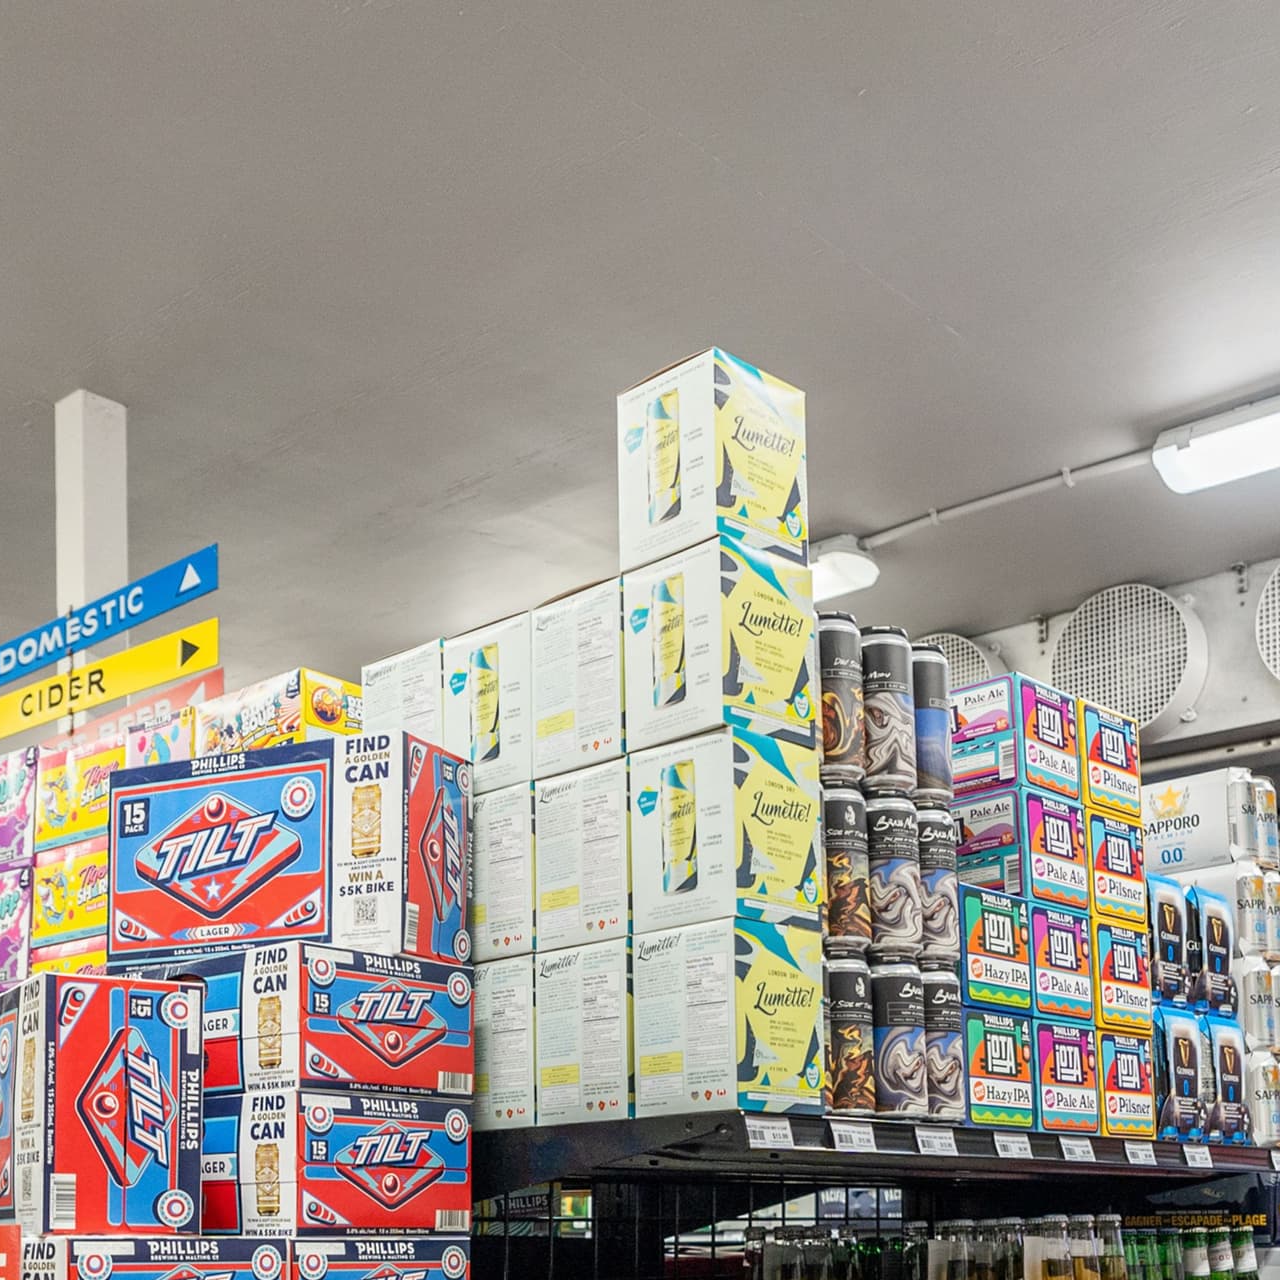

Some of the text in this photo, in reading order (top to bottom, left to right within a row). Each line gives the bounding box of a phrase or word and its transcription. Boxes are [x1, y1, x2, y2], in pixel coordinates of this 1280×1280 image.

[21, 669, 105, 717] CIDER
[346, 735, 390, 754] FIND
[191, 754, 245, 771] PHILLIPS
[344, 751, 390, 764] A GOLDEN
[1039, 750, 1076, 776] Pale Ale
[345, 761, 389, 783] CAN
[1103, 770, 1136, 795] Pilsner
[123, 803, 145, 824] 15
[125, 823, 144, 833] PACK
[1142, 814, 1200, 836] SAPPORO
[158, 812, 275, 880] TILT
[1161, 847, 1182, 864] 0.0
[349, 870, 384, 882] WIN A
[339, 881, 394, 897] $5K BIKE
[981, 893, 1012, 910] PHILLIPS
[200, 927, 230, 938] LAGER
[984, 963, 1028, 985] Hazy IPA
[1056, 1091, 1095, 1109] Pale Ale
[1119, 1097, 1151, 1115] Pilsner
[1125, 1216, 1162, 1226] GAGNER
[1172, 1216, 1222, 1226] ESCAPADE
[1232, 1215, 1267, 1226] PLAGE
[22, 1243, 56, 1264] FIND
[148, 1241, 219, 1255] PHILLIPS
